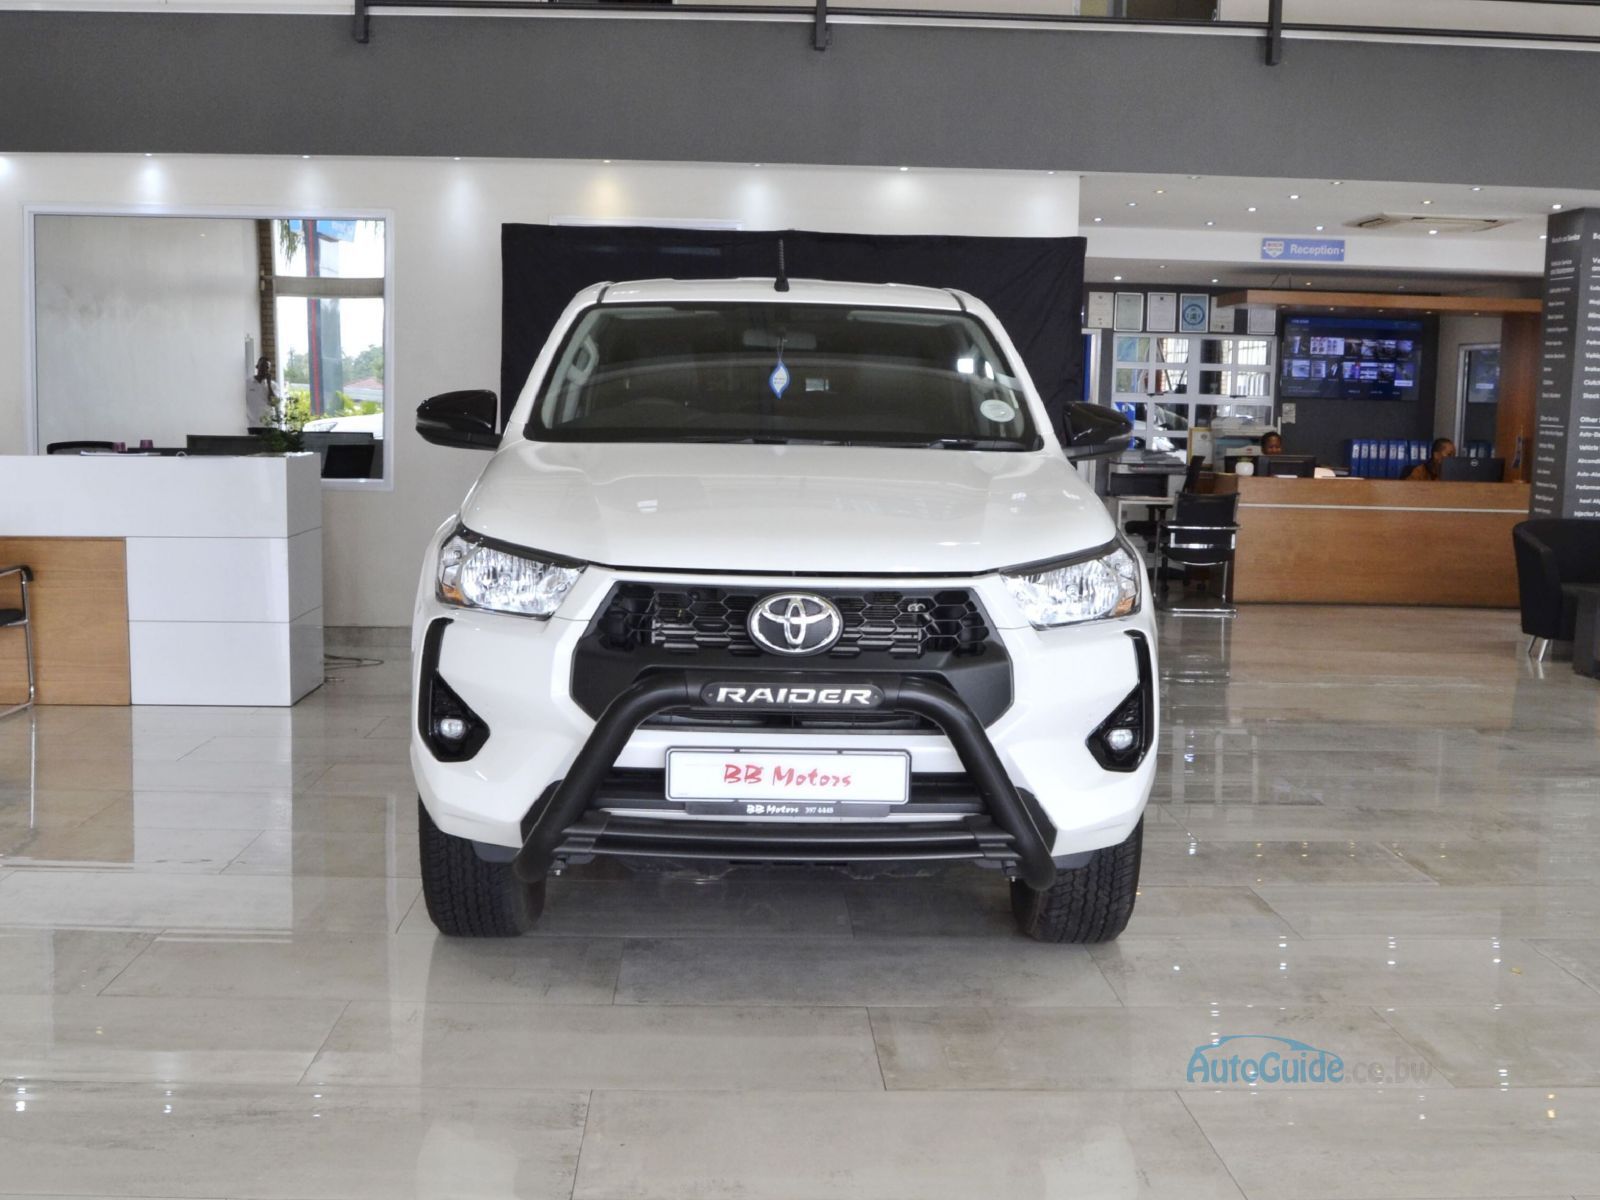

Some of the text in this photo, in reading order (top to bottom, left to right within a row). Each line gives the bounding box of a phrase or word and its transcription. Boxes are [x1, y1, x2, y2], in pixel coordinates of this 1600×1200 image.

[1290, 243, 1339, 256] Reception
[716, 687, 872, 705] RAIDER
[723, 764, 852, 787] BB Motors
[746, 804, 765, 814] BB
[766, 805, 799, 814] Motors
